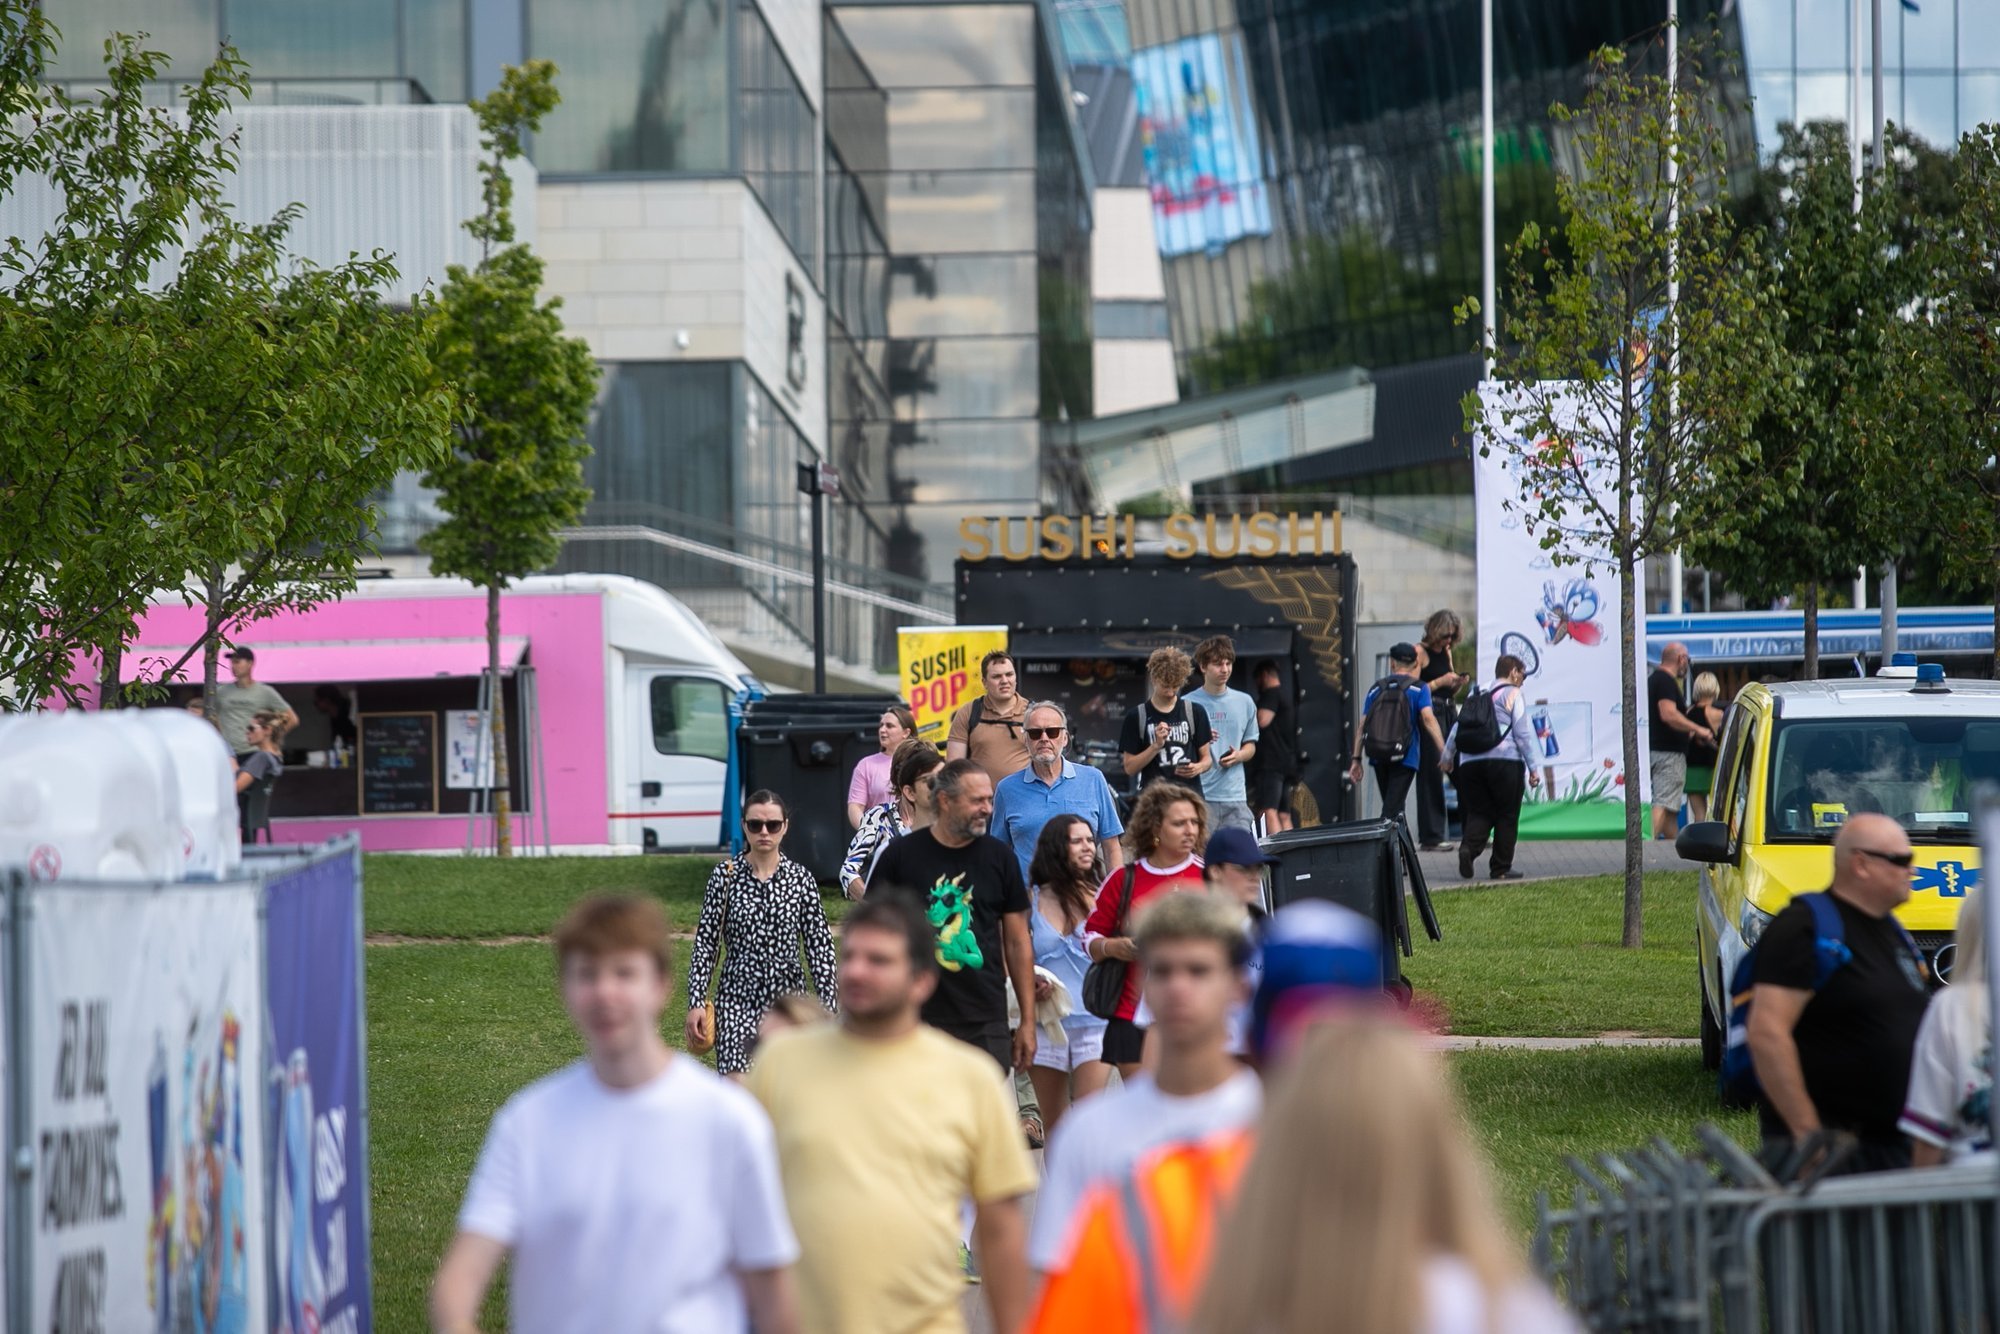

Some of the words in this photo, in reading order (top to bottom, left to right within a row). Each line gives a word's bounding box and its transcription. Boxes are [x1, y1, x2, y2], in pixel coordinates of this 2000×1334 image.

[958, 514, 1135, 562] SUSHI
[1164, 511, 1342, 559] SUSHI
[910, 645, 966, 685] SUSHI
[911, 671, 968, 721] POP
[1147, 721, 1189, 745] MPHIS
[1159, 746, 1185, 767] 12
